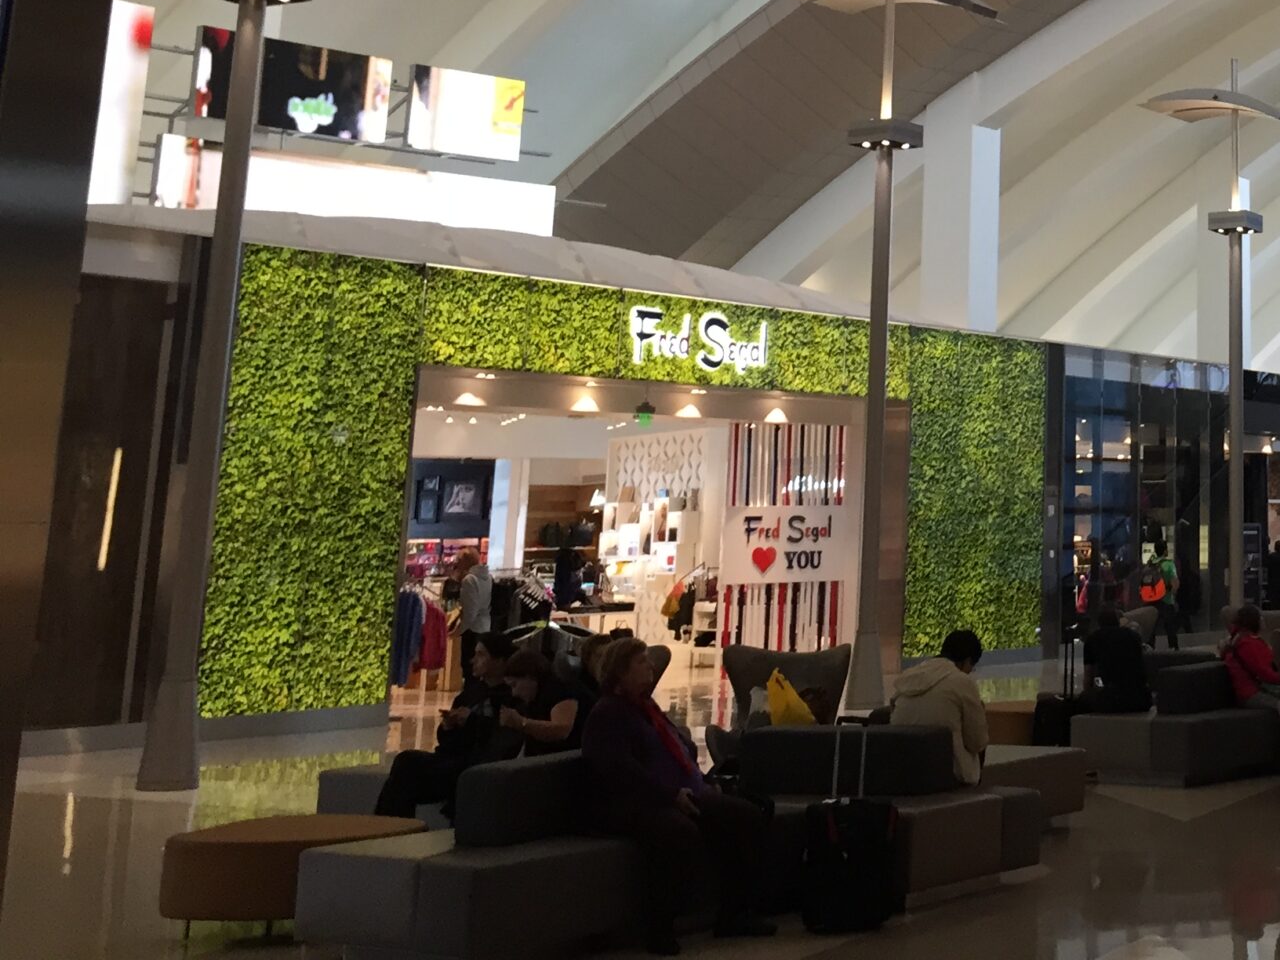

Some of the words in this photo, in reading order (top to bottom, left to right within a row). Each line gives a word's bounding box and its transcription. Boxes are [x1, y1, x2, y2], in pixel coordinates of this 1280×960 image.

[632, 307, 692, 364] Fred
[697, 312, 768, 374] Segal
[743, 515, 781, 545] Fred
[786, 514, 832, 543] Segal
[784, 550, 822, 570] YOU
